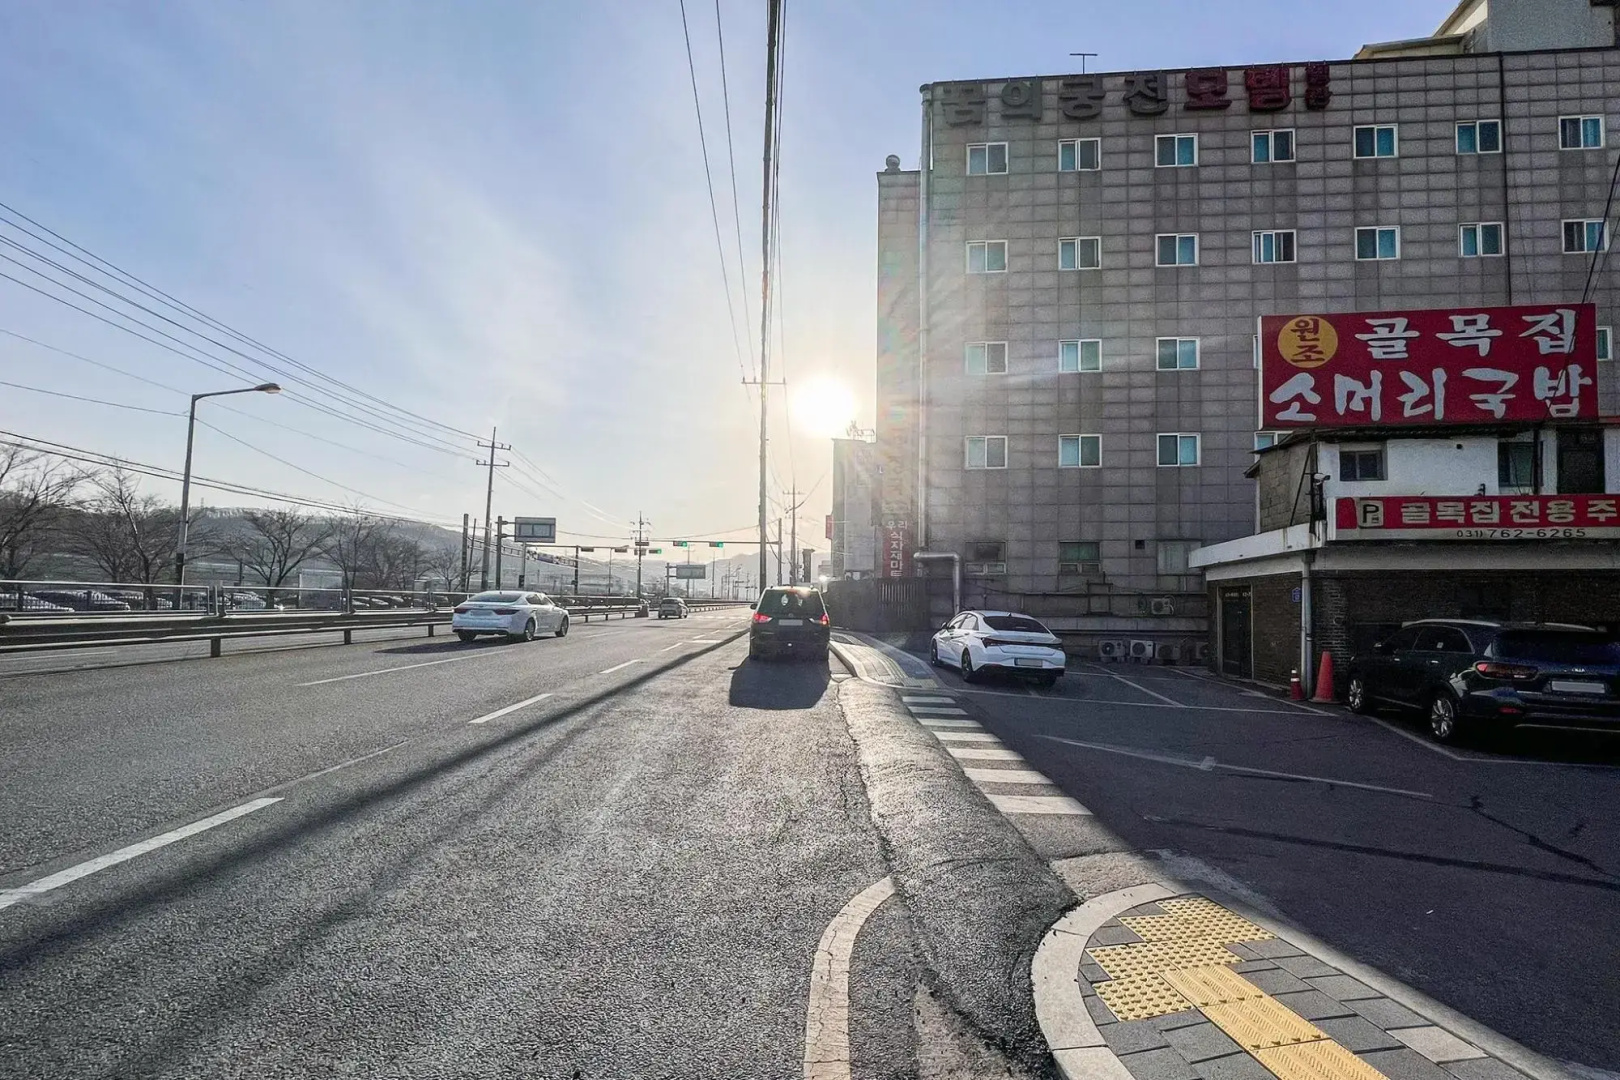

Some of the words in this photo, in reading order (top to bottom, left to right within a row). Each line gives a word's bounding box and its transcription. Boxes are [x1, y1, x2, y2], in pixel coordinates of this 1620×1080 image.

[1290, 316, 1326, 363] 원조
[1355, 308, 1576, 360] 골목집
[1268, 364, 1593, 421] 소머리국밥
[1400, 501, 1500, 525] 골목집
[1509, 500, 1576, 524] 전용
